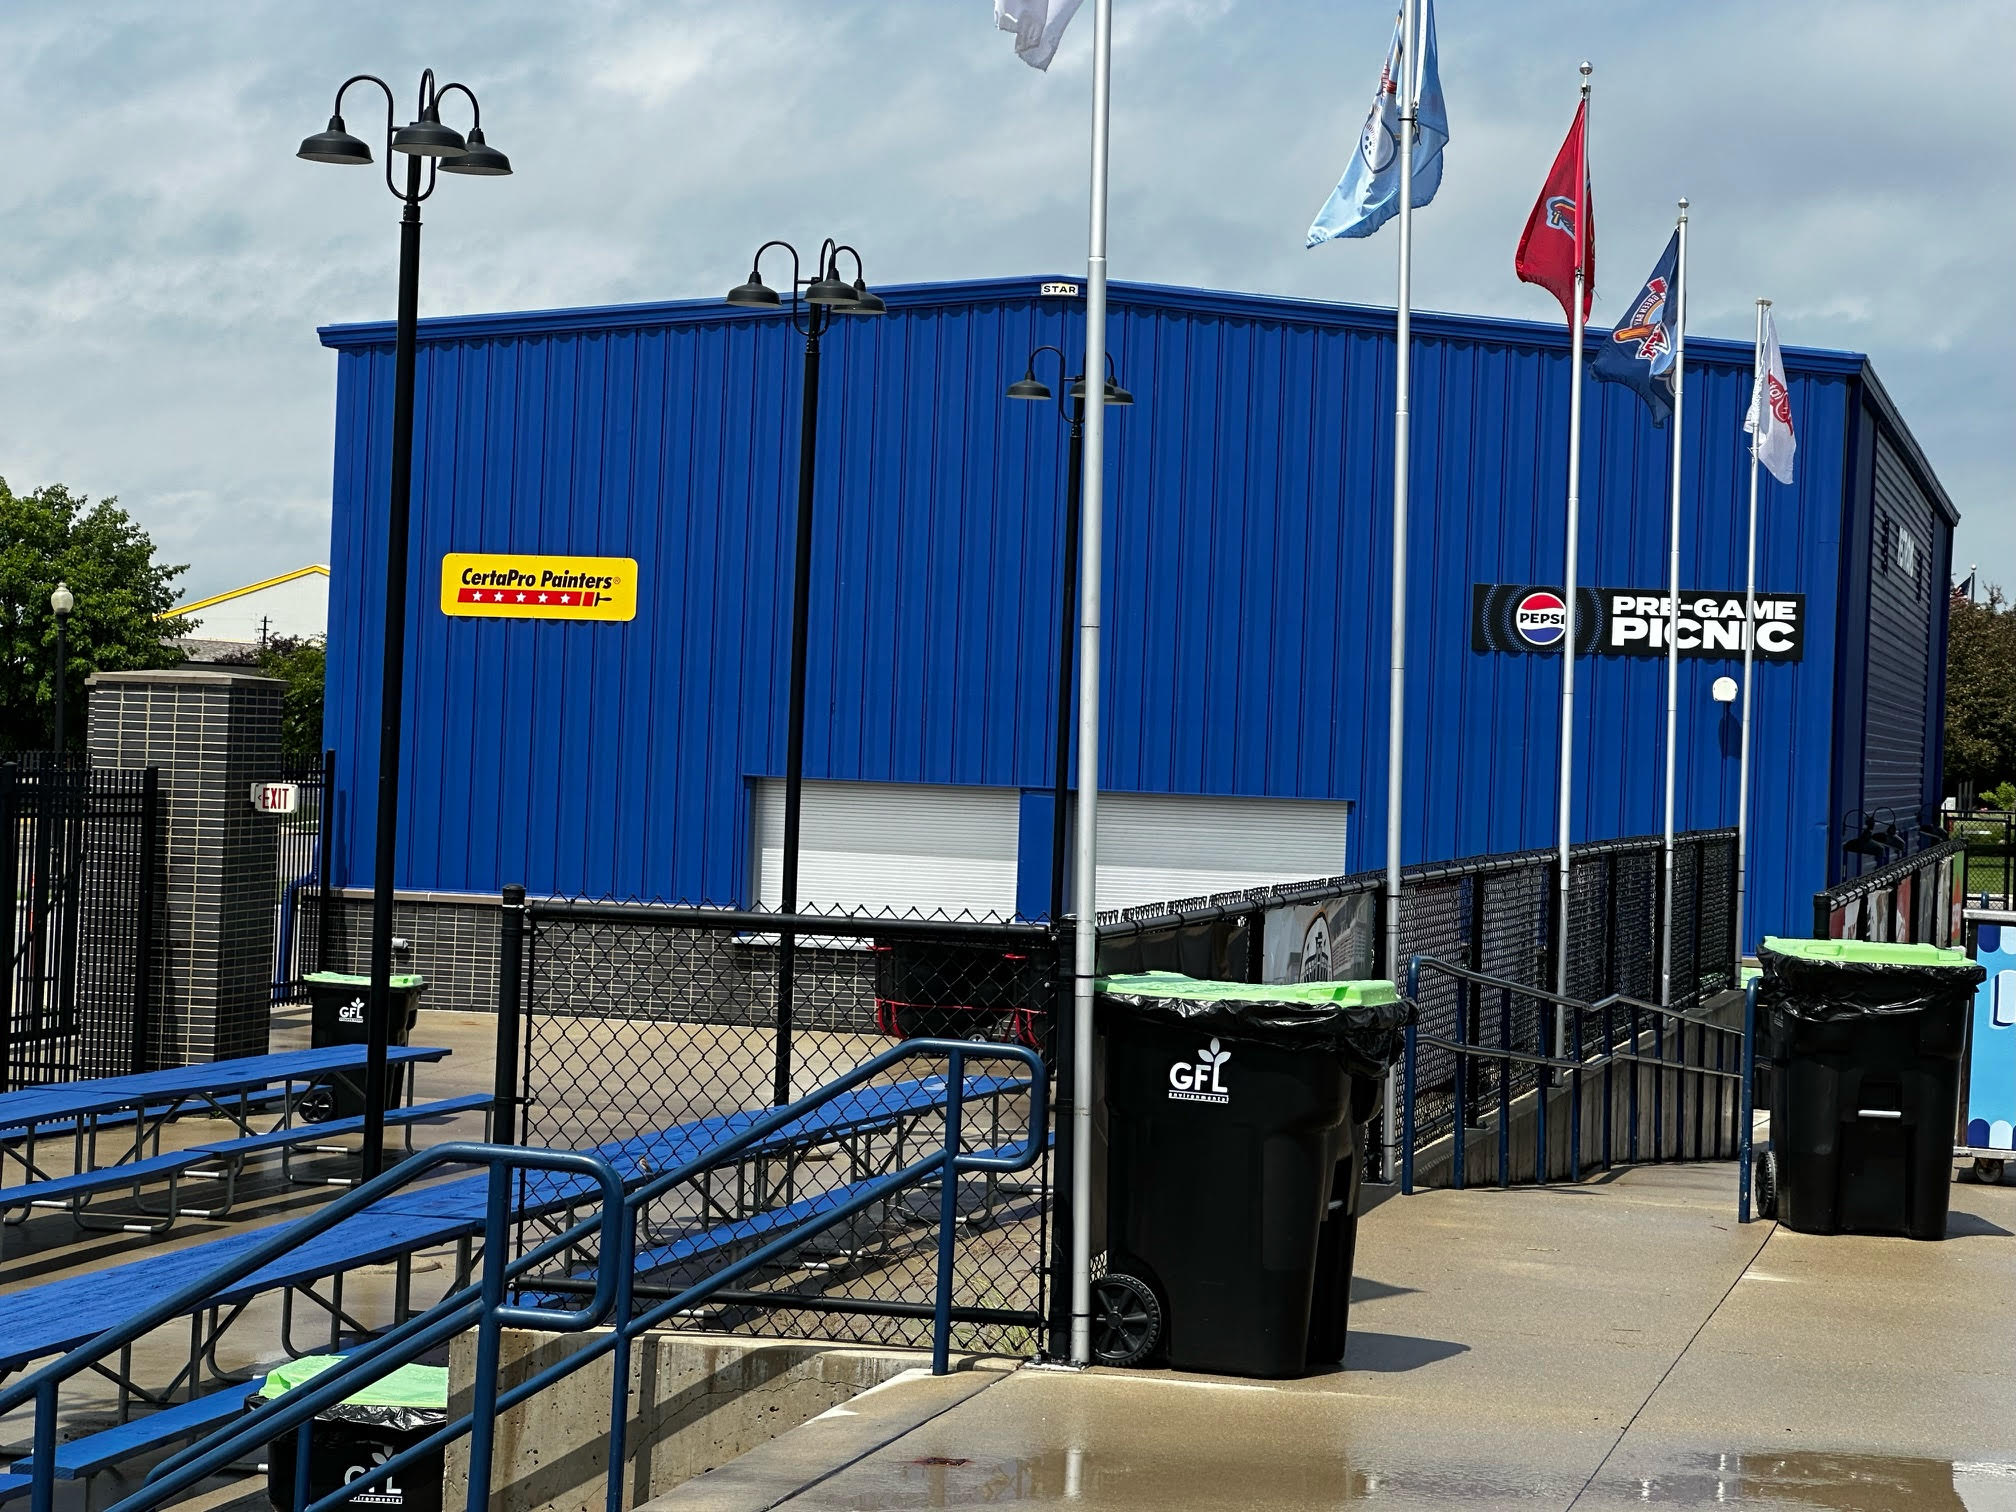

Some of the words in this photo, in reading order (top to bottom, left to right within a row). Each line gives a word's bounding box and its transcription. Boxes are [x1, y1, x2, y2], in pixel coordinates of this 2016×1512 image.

[1043, 285, 1076, 293] STAR
[461, 568, 536, 587] CertaPro
[1612, 595, 1797, 621] PRE-GAME
[1519, 613, 1565, 625] PEPSI
[262, 787, 289, 809] EXIT
[339, 1003, 364, 1018] GFL
[1169, 1052, 1229, 1093] GFL
